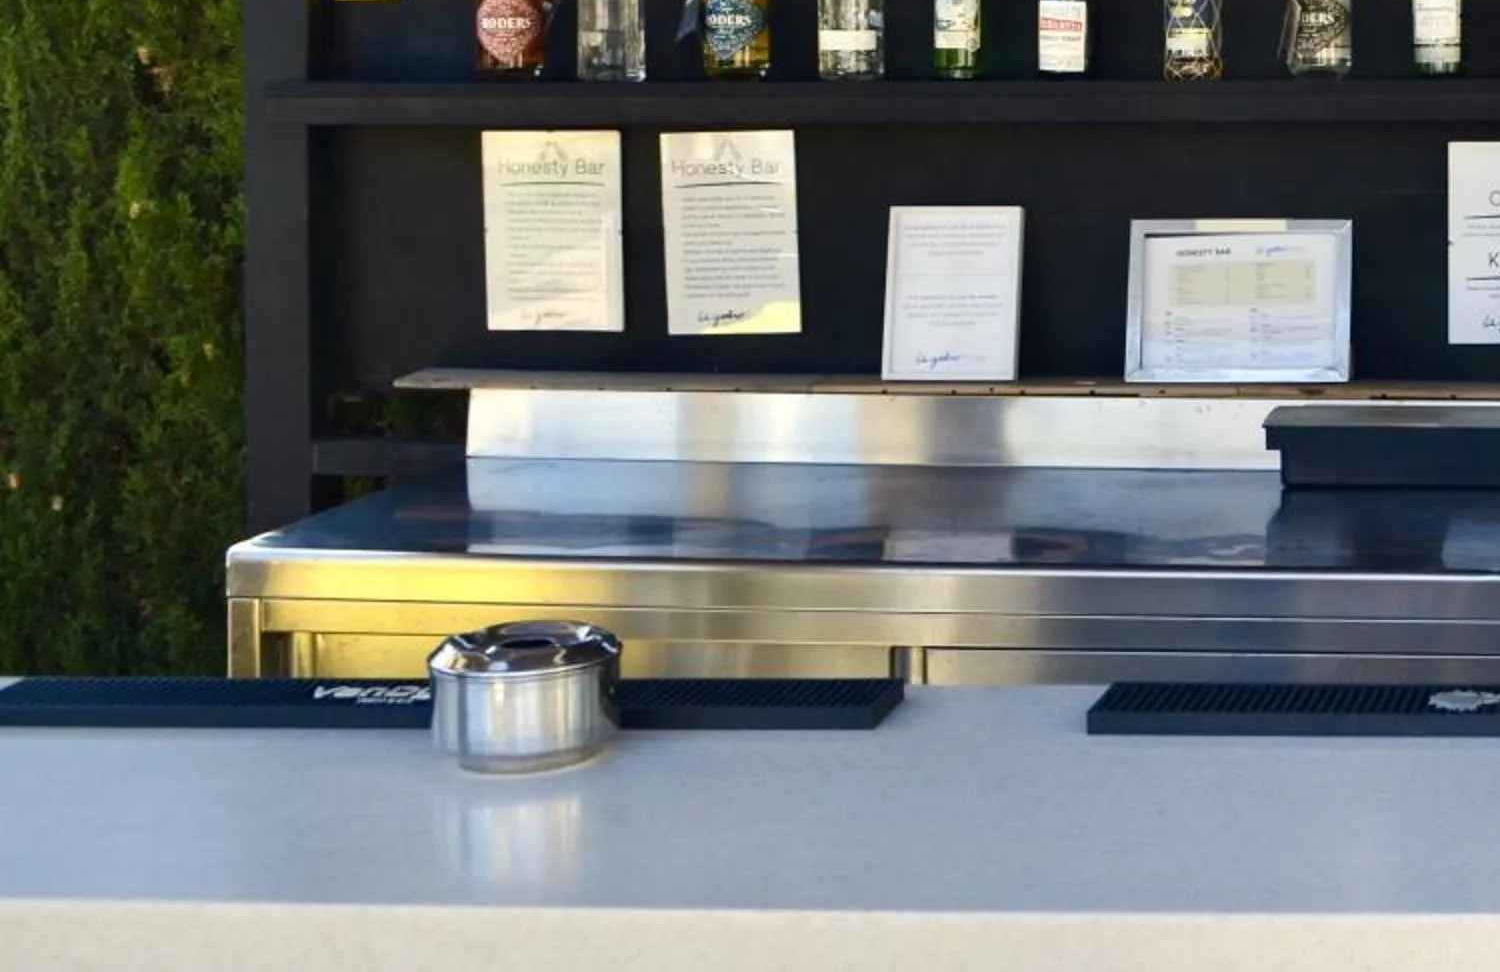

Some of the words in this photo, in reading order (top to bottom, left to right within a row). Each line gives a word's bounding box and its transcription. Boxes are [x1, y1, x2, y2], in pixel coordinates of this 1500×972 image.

[498, 159, 569, 178] Honesty
[575, 158, 606, 176] Bar
[671, 159, 745, 179] Honesty
[751, 158, 782, 176] Bar
